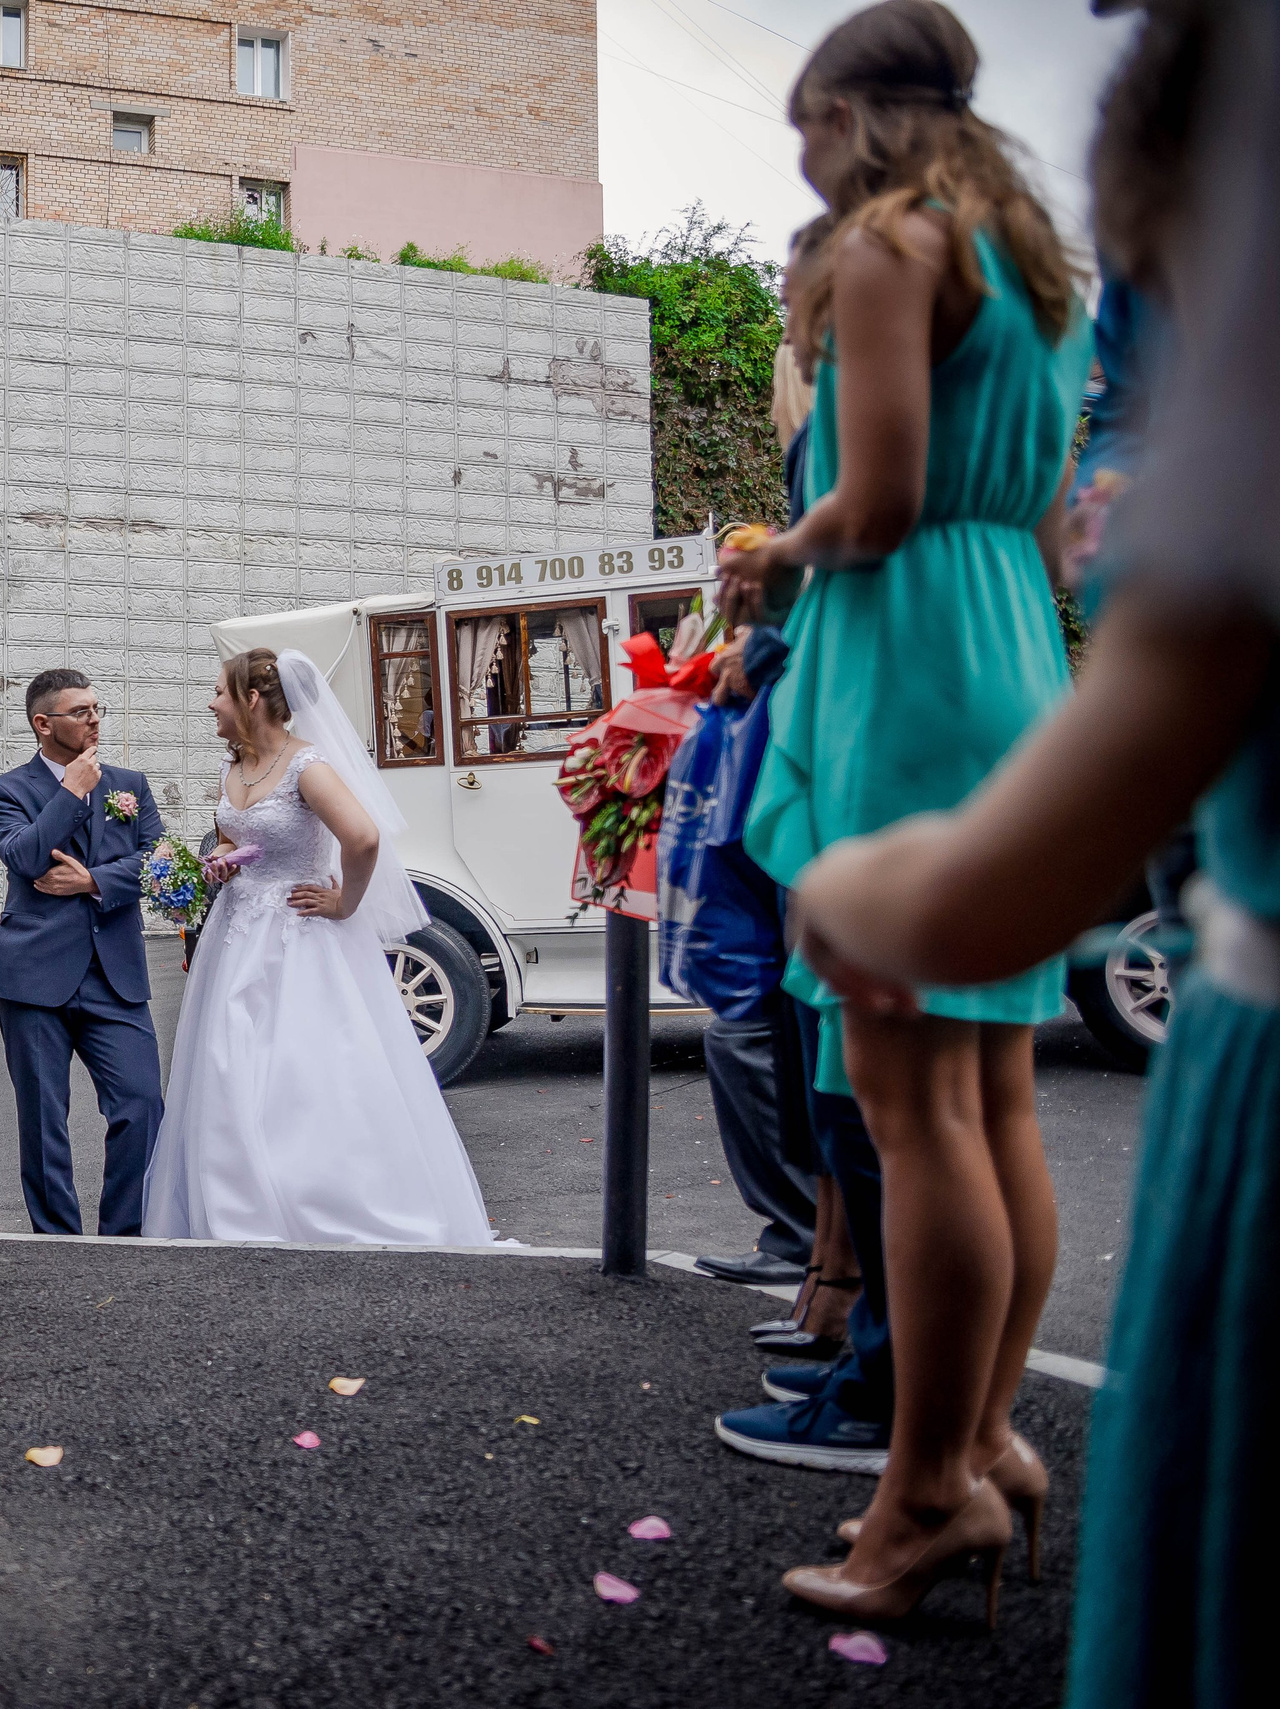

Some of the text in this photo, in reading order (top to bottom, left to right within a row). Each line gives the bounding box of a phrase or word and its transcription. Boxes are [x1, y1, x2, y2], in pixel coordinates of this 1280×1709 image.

[447, 545, 685, 592] 8 914 700 83 93
